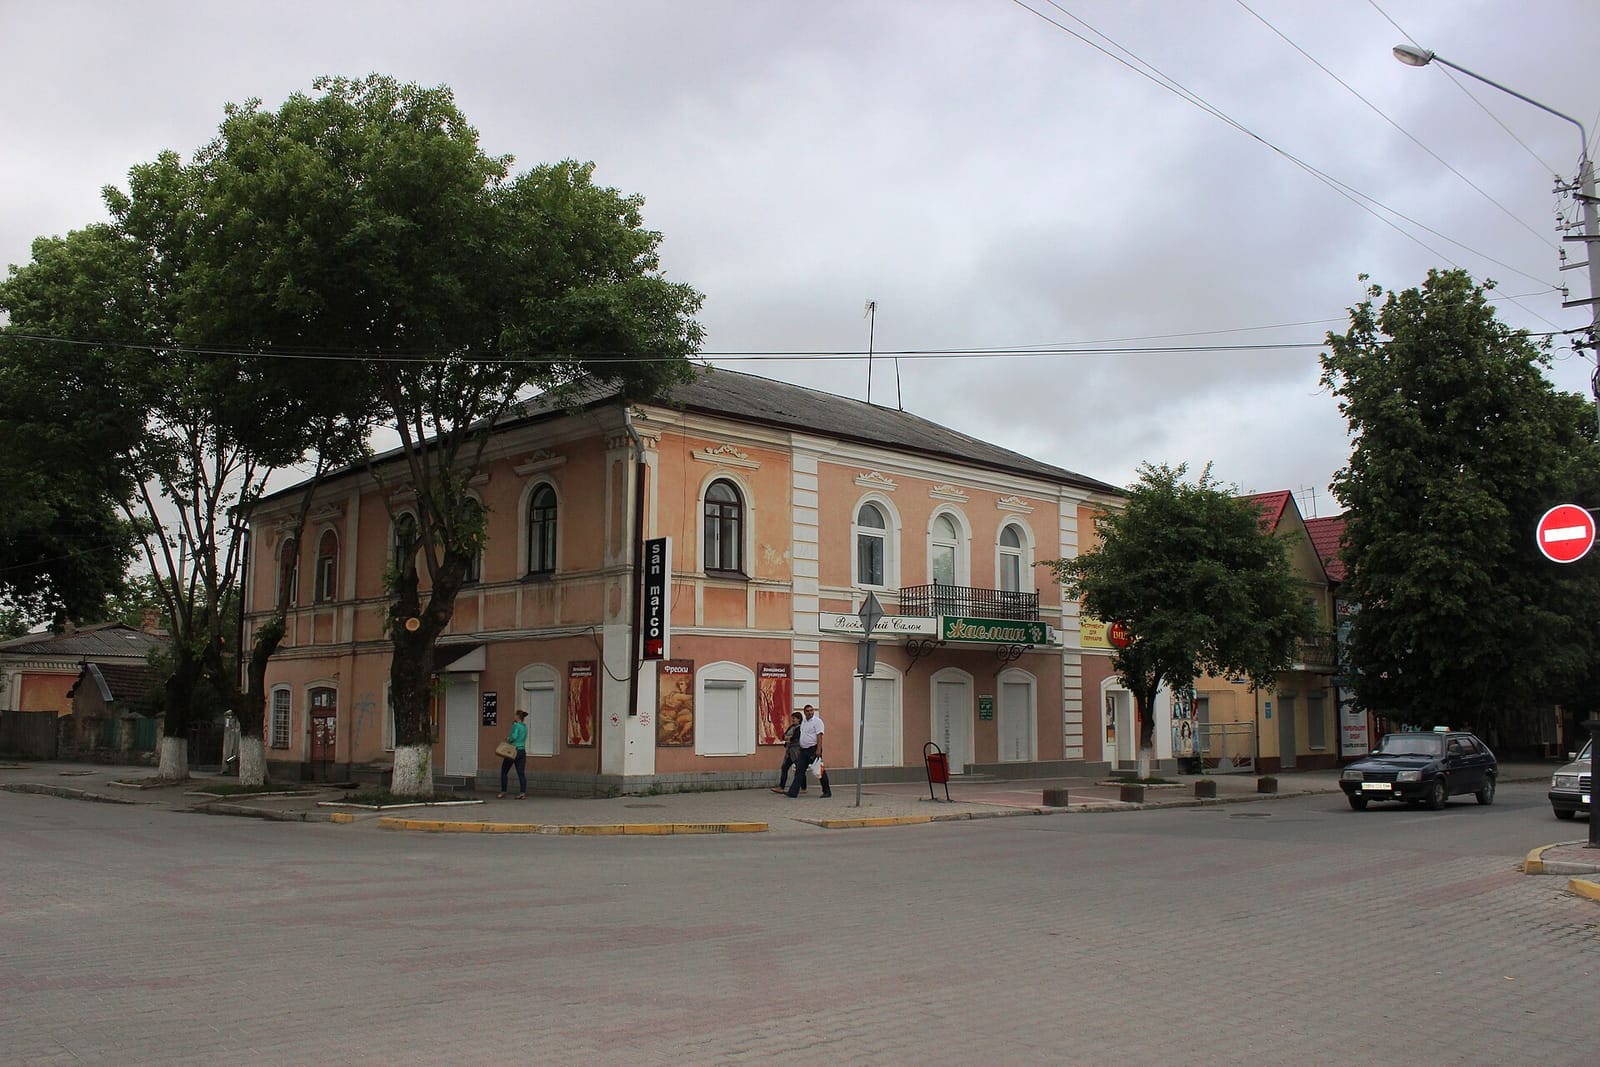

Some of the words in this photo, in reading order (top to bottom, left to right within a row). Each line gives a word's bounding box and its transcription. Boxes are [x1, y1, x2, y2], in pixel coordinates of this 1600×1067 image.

[651, 543, 661, 575] san
[650, 585, 660, 637] marco
[891, 617, 922, 631] Салон
[946, 618, 1026, 641] Жасмин
[664, 665, 689, 675] Фрески
